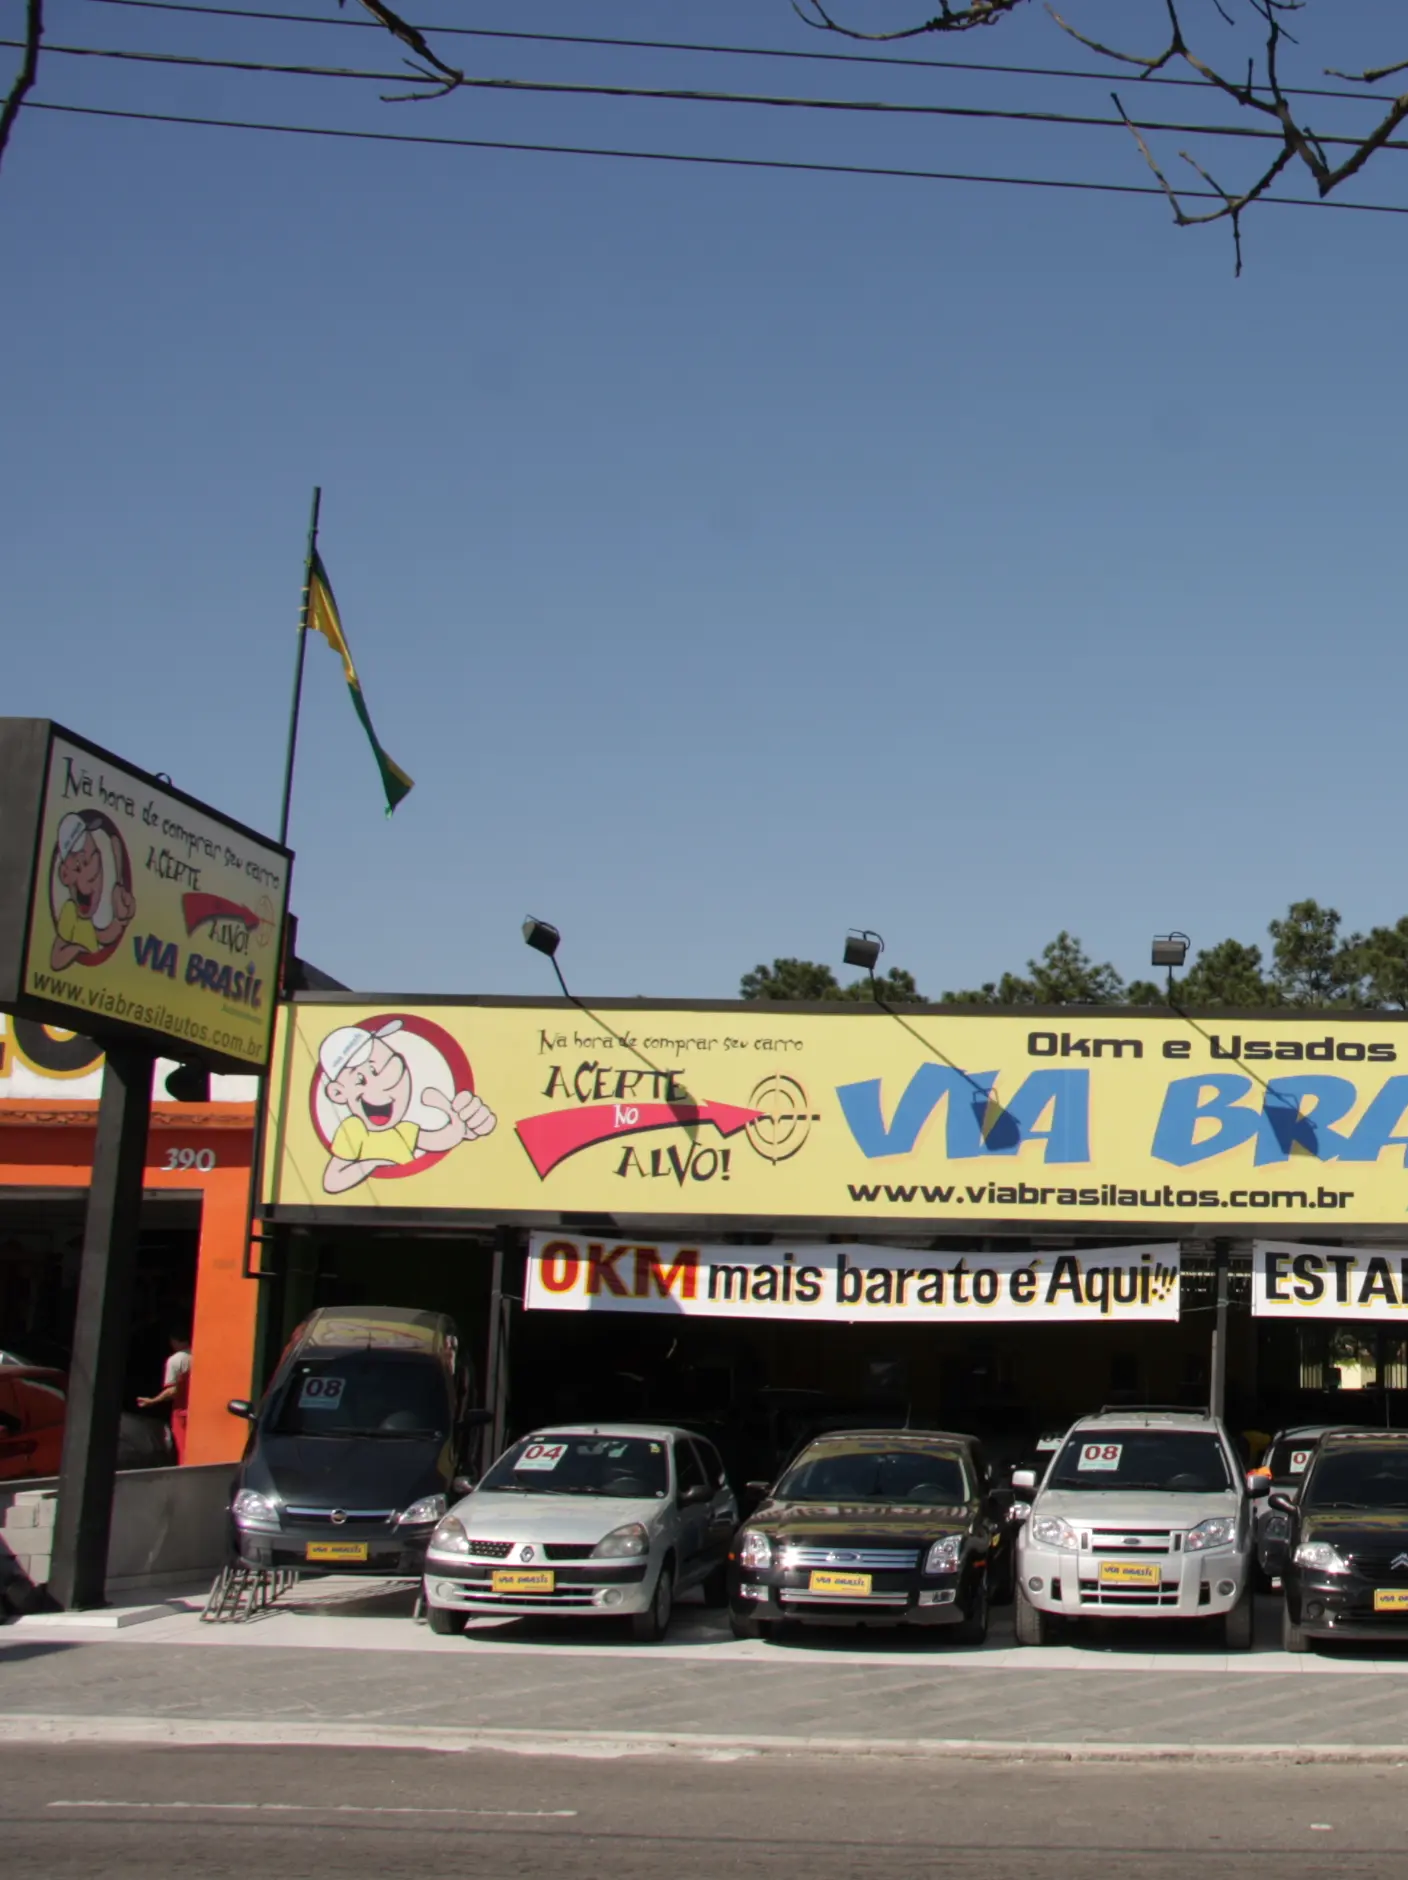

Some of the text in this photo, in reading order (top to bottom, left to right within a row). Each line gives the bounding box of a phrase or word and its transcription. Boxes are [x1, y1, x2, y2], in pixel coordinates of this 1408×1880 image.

[62, 756, 280, 890] Na hora de comprar seu carro
[145, 845, 202, 891] ACERTE
[133, 932, 180, 981] VIA
[33, 971, 264, 1057] www.viabrasilautos.com.br
[538, 1028, 804, 1058] Na hora de comprar seu carro
[1162, 1039, 1192, 1059] e
[1209, 1035, 1398, 1062] Usados
[540, 1060, 686, 1103] ACERTE
[613, 1102, 640, 1128] NO
[835, 1062, 1091, 1164] VIA
[159, 1147, 217, 1173] 390
[613, 1139, 732, 1188] ALVO!
[847, 1181, 1355, 1209] www.viabrasilautos.com.br
[708, 1252, 824, 1304] mais
[836, 1253, 1001, 1307] barato
[1009, 1258, 1043, 1307] é
[306, 1378, 343, 1398] 08
[524, 1443, 564, 1461] 04
[1084, 1445, 1120, 1462] 08
